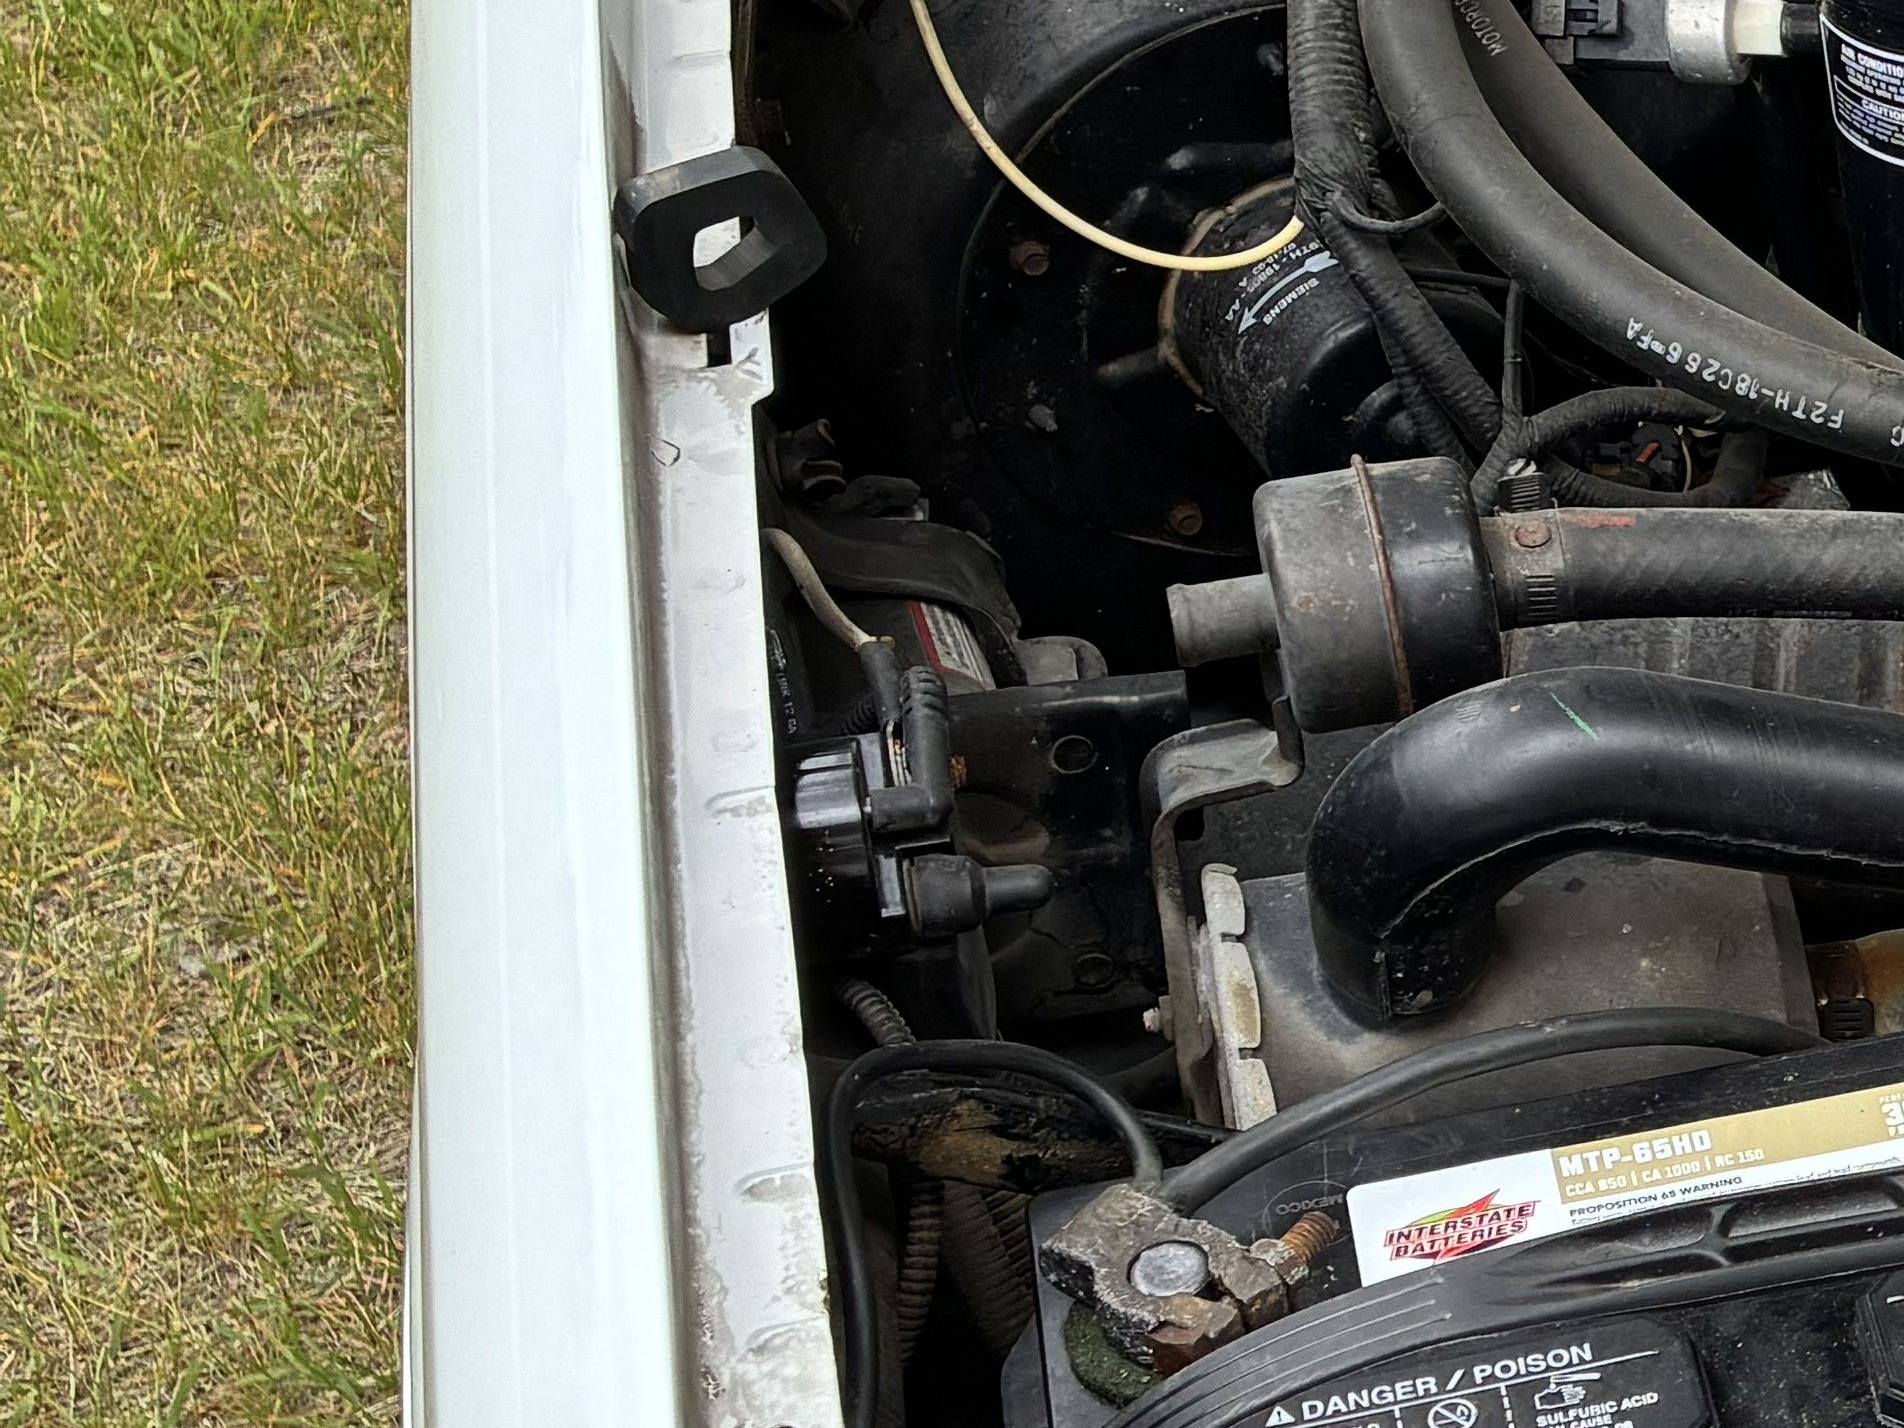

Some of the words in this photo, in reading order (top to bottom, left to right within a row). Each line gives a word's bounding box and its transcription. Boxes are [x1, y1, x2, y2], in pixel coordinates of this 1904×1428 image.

[1262, 277, 1320, 326] SIEMENS
[1558, 1128, 1712, 1178] MTP-65HD
[1568, 1192, 1658, 1217] PROPOSITION
[1678, 1176, 1743, 1195] WARNING
[1386, 1201, 1533, 1247] INTERSTATE
[1391, 1220, 1527, 1260] BATTERIES
[1300, 1374, 1438, 1420] DANGER
[1472, 1341, 1594, 1384] POISON
[1534, 1400, 1618, 1428] SULFURIC
[1620, 1390, 1660, 1410] ACID
